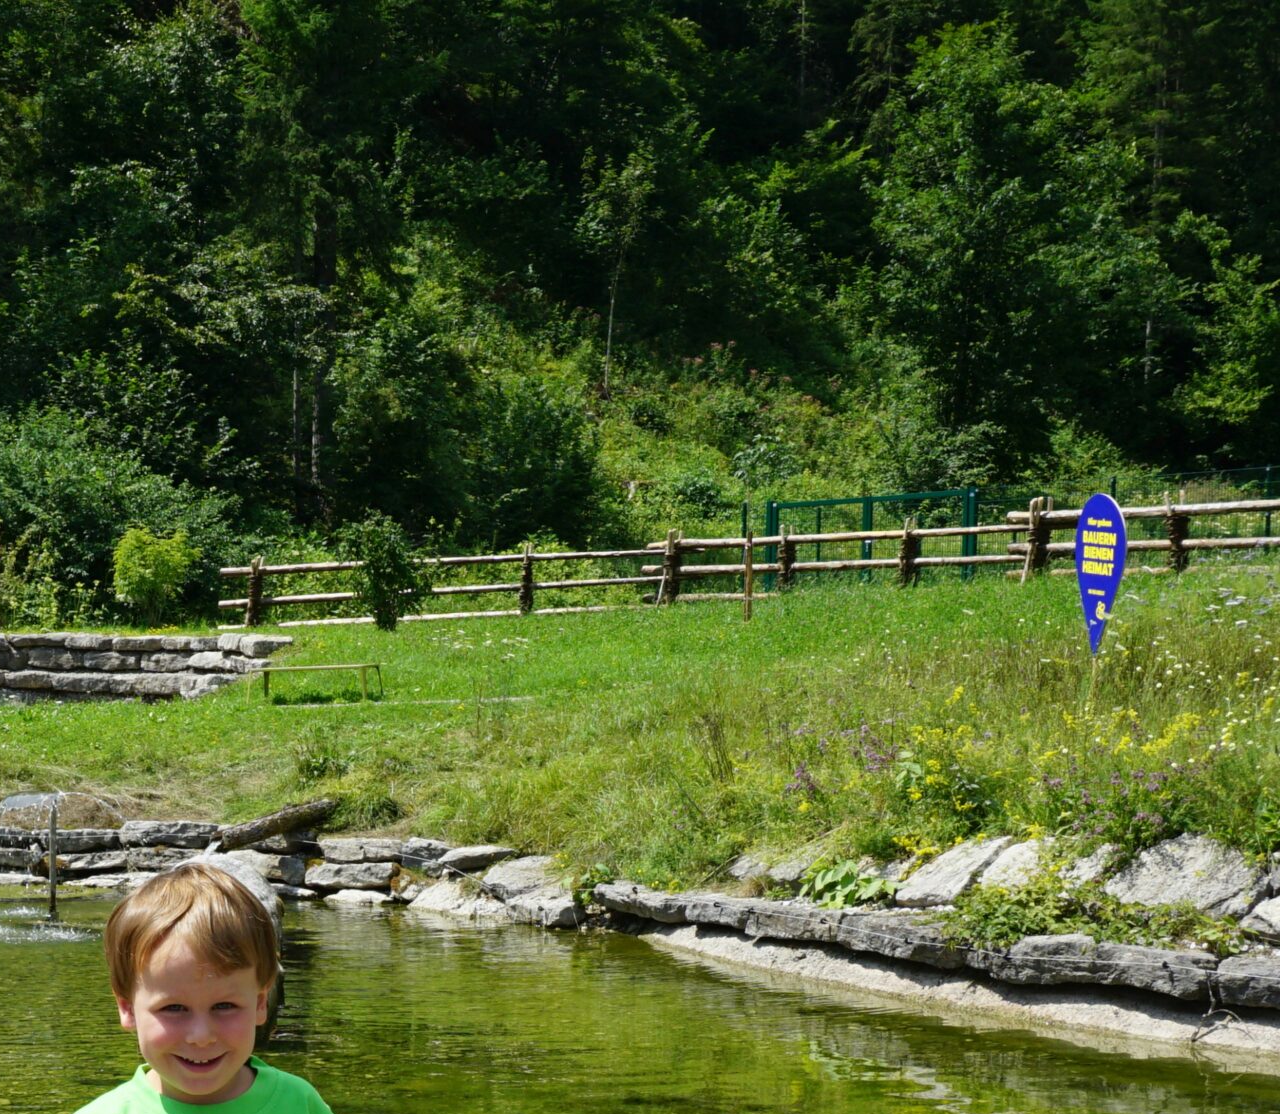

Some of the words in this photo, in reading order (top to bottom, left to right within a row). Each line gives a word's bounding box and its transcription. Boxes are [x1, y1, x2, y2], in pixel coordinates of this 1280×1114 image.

[1083, 531, 1116, 546] BAUERN
[1084, 546, 1114, 560] BIENEN
[1082, 560, 1114, 575] HEIMAT
